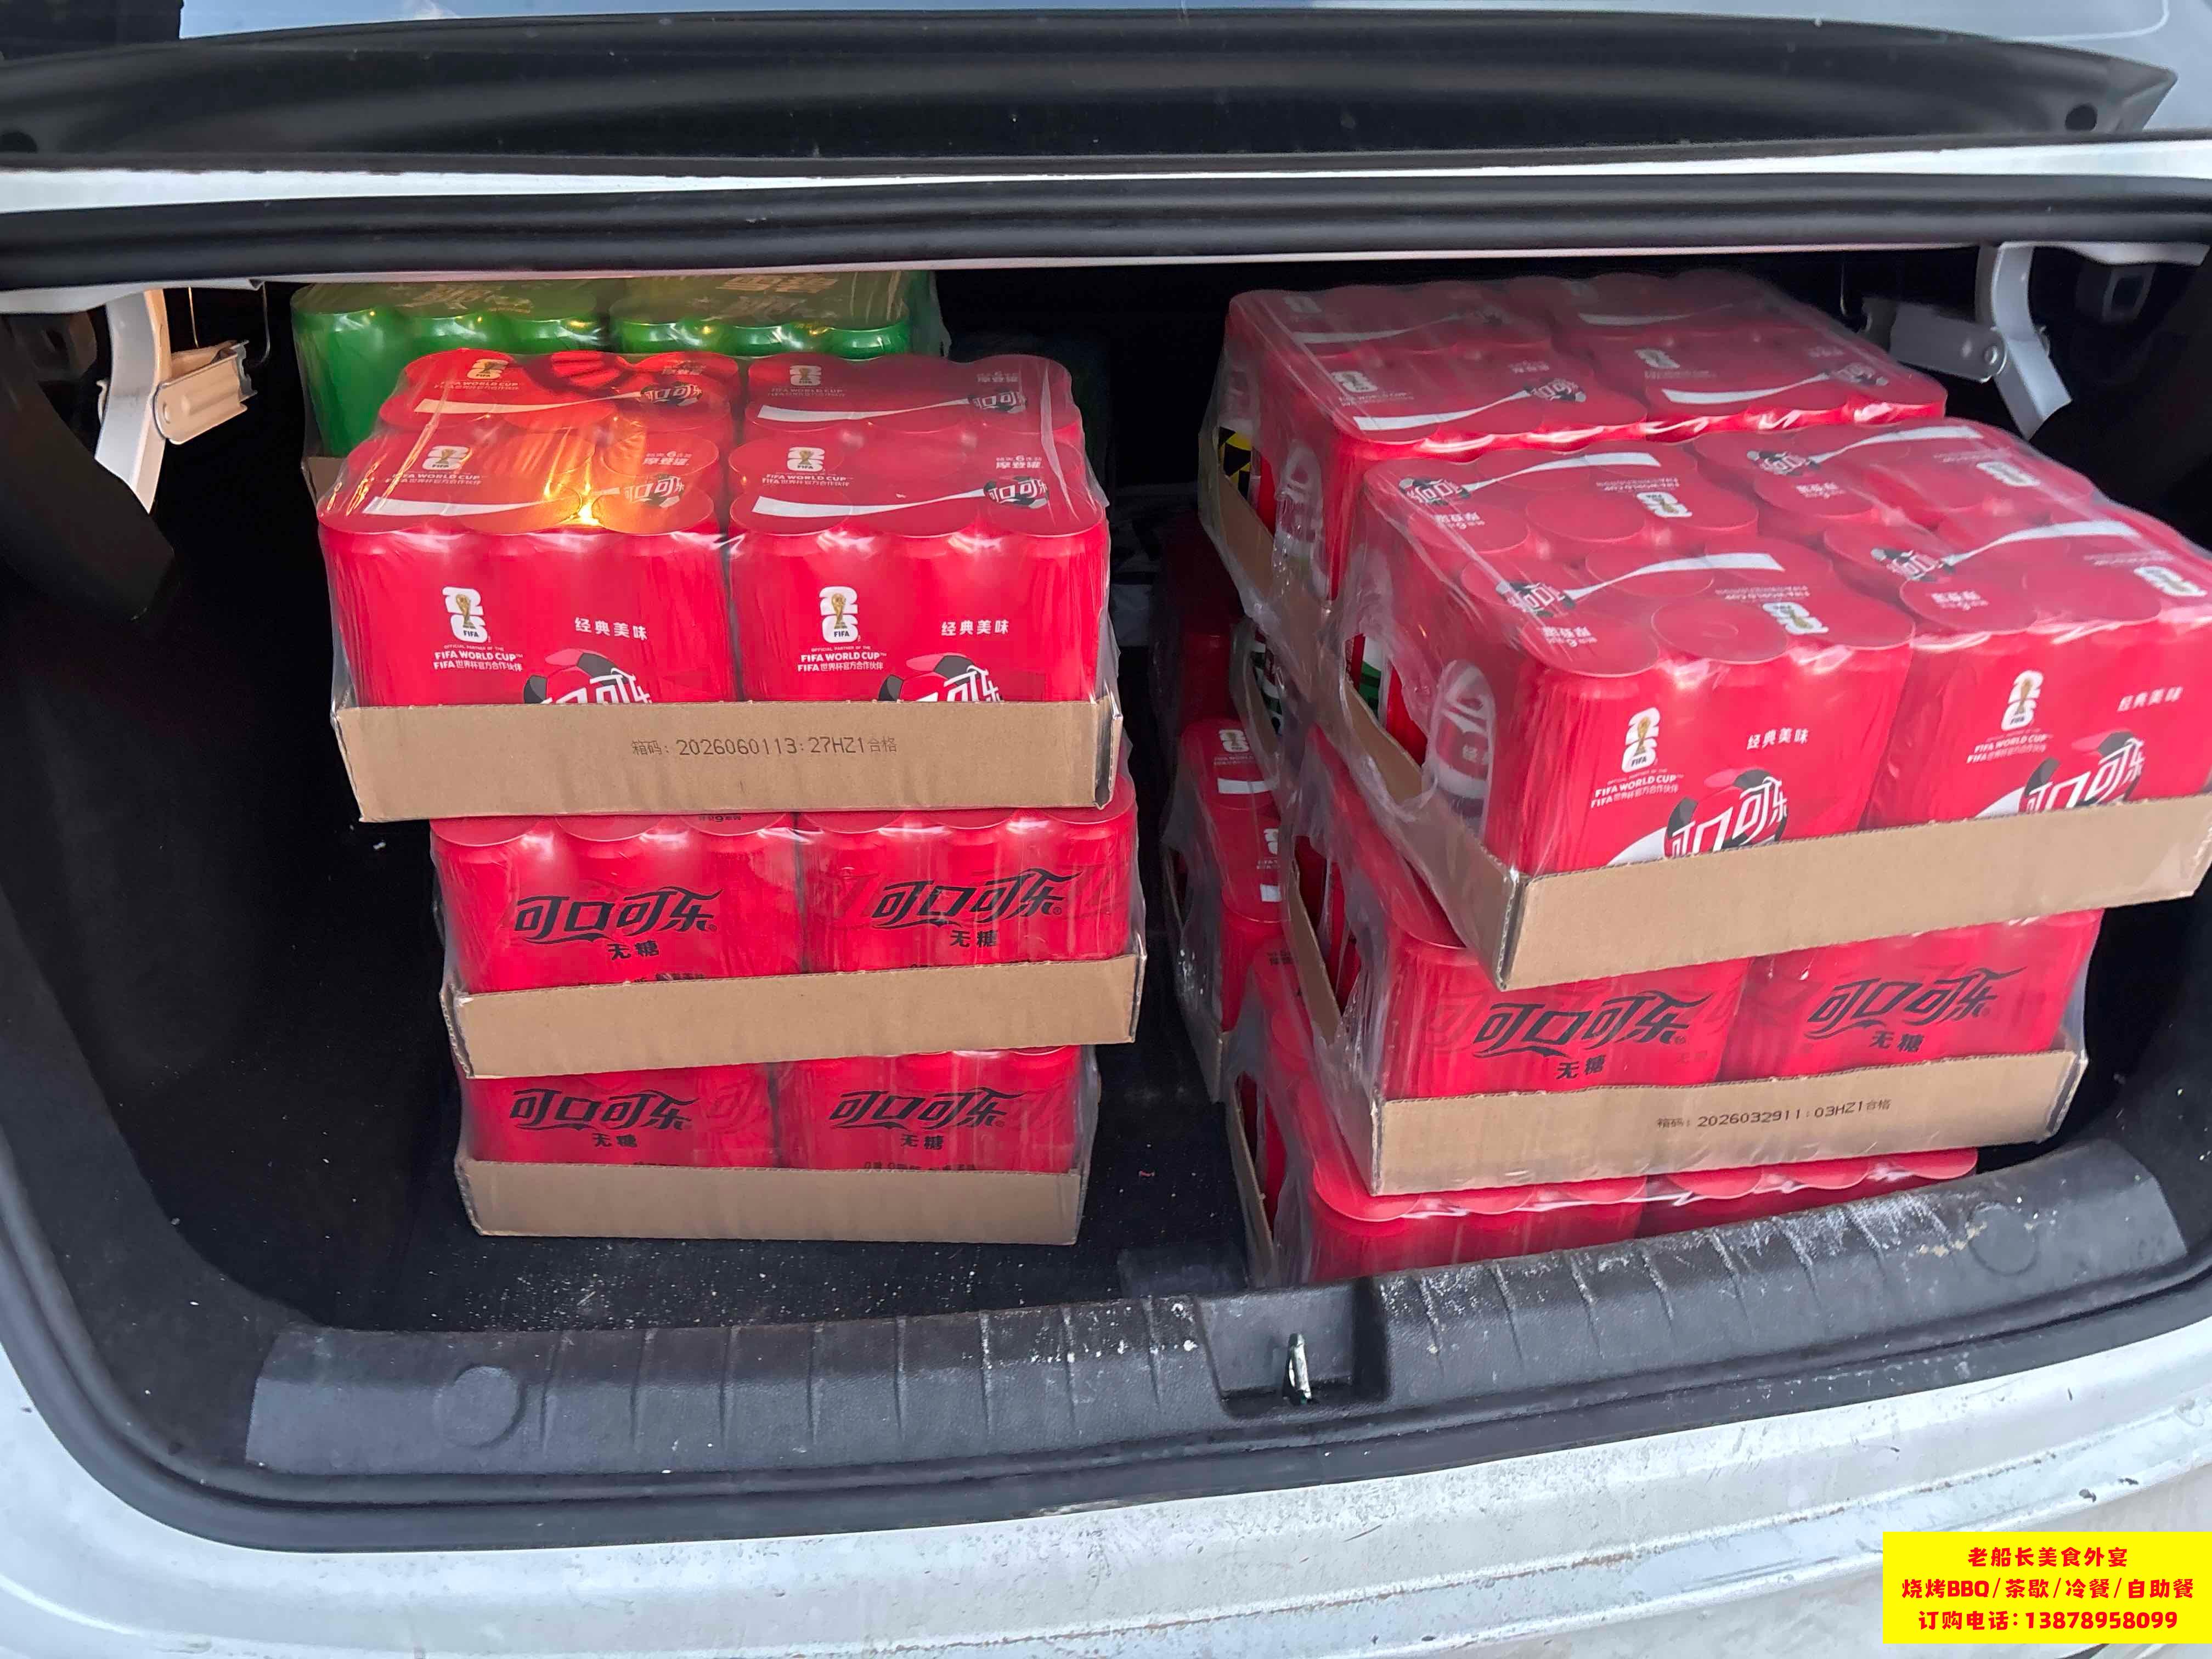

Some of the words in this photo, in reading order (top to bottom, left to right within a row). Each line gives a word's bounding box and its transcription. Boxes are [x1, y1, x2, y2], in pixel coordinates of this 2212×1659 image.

[574, 616, 648, 641] 经典美味
[940, 619, 1010, 637] 经典美味
[434, 650, 458, 660] FIFA
[459, 650, 494, 661] WORLD
[800, 653, 824, 663] FIFA
[825, 652, 860, 662] WORLD
[1746, 727, 1809, 751] 经典美味
[1974, 742, 1994, 754] FIFA
[1995, 735, 2028, 749] WORLD
[1631, 756, 1647, 767] FIFA
[1595, 785, 1618, 798] FIFA
[1619, 776, 1655, 792] WORLD
[949, 929, 999, 949] 无糖
[607, 939, 660, 961] 无糖
[1869, 1030, 1925, 1053] 无糖
[1556, 1053, 1607, 1080] 无糖
[592, 1132, 639, 1148] 无糖
[900, 1133, 944, 1150] 无糖
